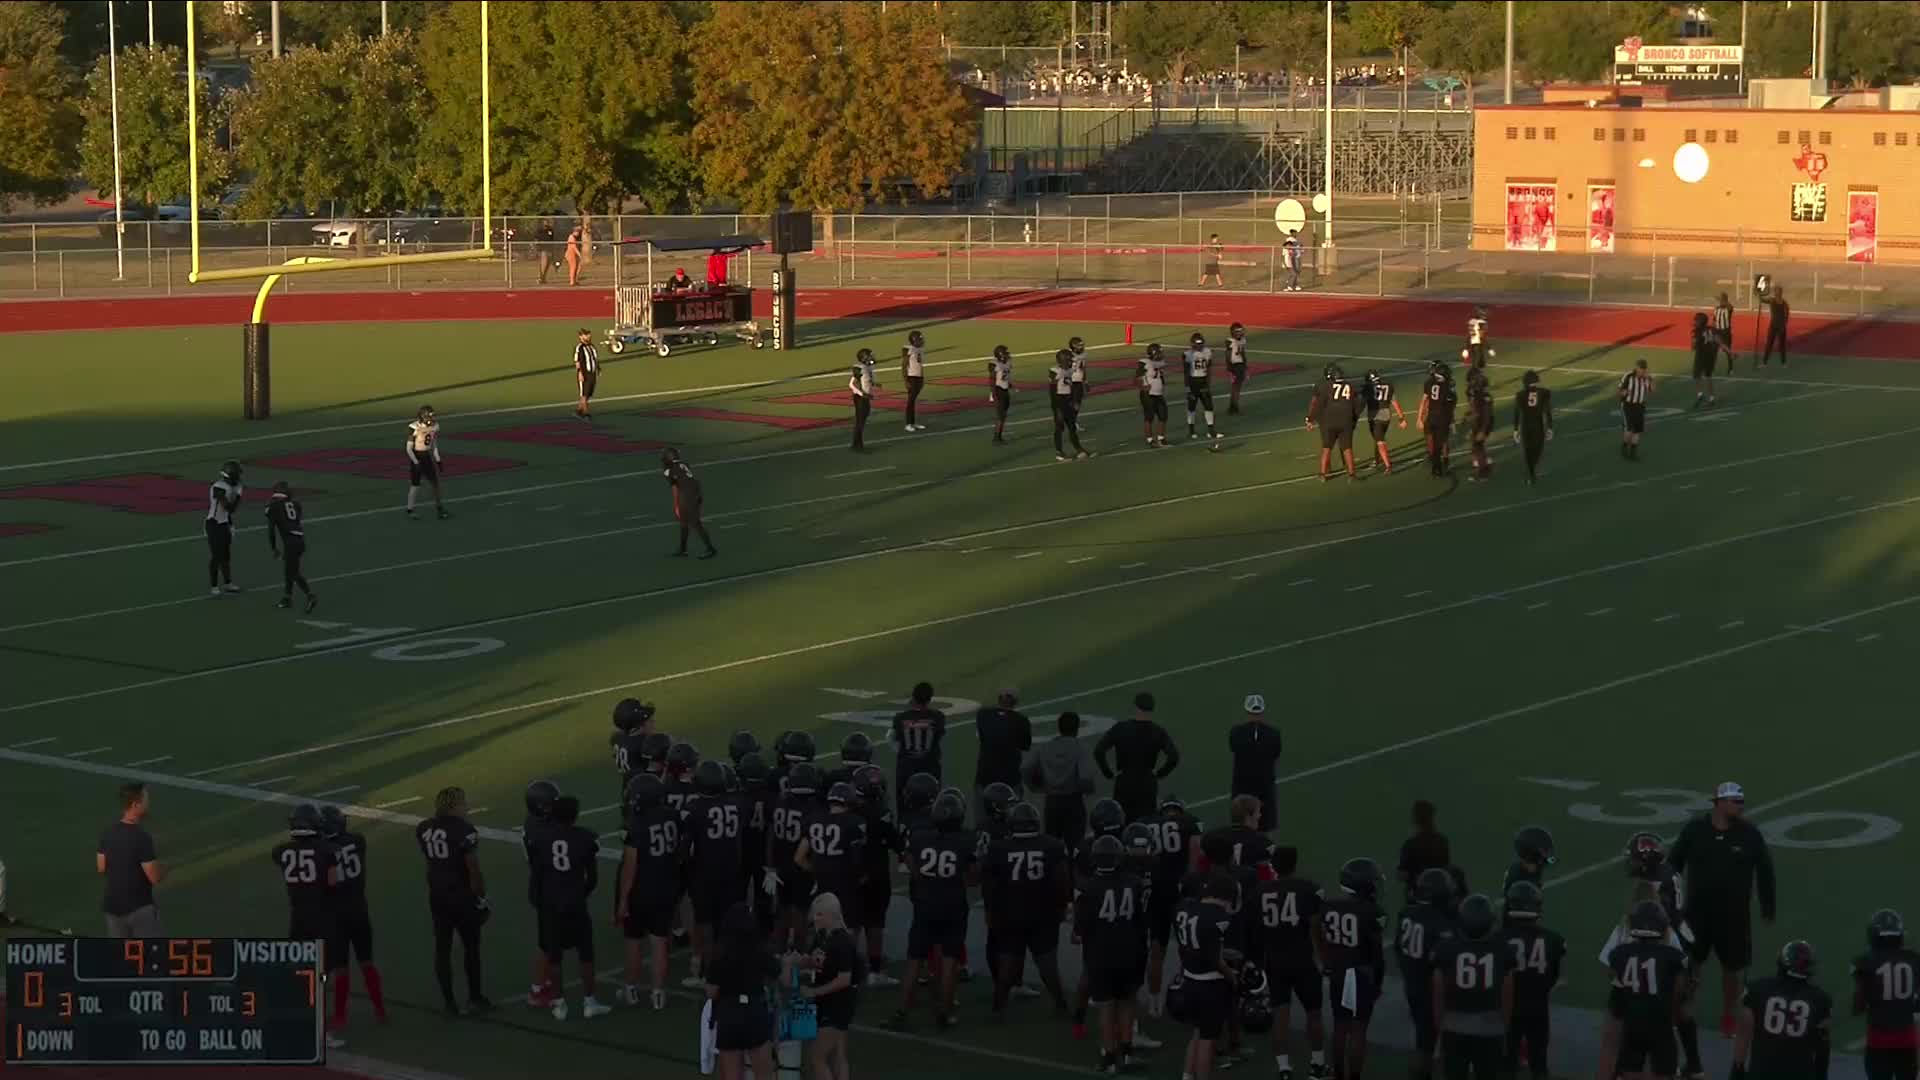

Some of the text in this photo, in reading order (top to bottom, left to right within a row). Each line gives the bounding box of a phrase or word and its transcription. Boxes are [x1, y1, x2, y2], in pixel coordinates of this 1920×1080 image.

[1643, 48, 1739, 60] BRONCO SOFTBALL
[675, 298, 734, 321] LEGACY
[1332, 384, 1351, 400] 74
[1528, 392, 1538, 407] 5
[706, 805, 739, 841] 35
[773, 807, 803, 842] 85
[809, 823, 845, 857] 82
[421, 829, 449, 859] 16
[551, 839, 571, 872] 8
[281, 848, 317, 884] 25
[919, 847, 958, 880] 26
[1007, 850, 1045, 882] 75
[1097, 887, 1136, 922] 44
[1261, 891, 1301, 928] 54
[1325, 911, 1359, 948] 39
[1455, 952, 1494, 991] 61
[1621, 956, 1658, 996] 41
[1874, 962, 1914, 1001] 10
[1762, 995, 1811, 1038] 63
